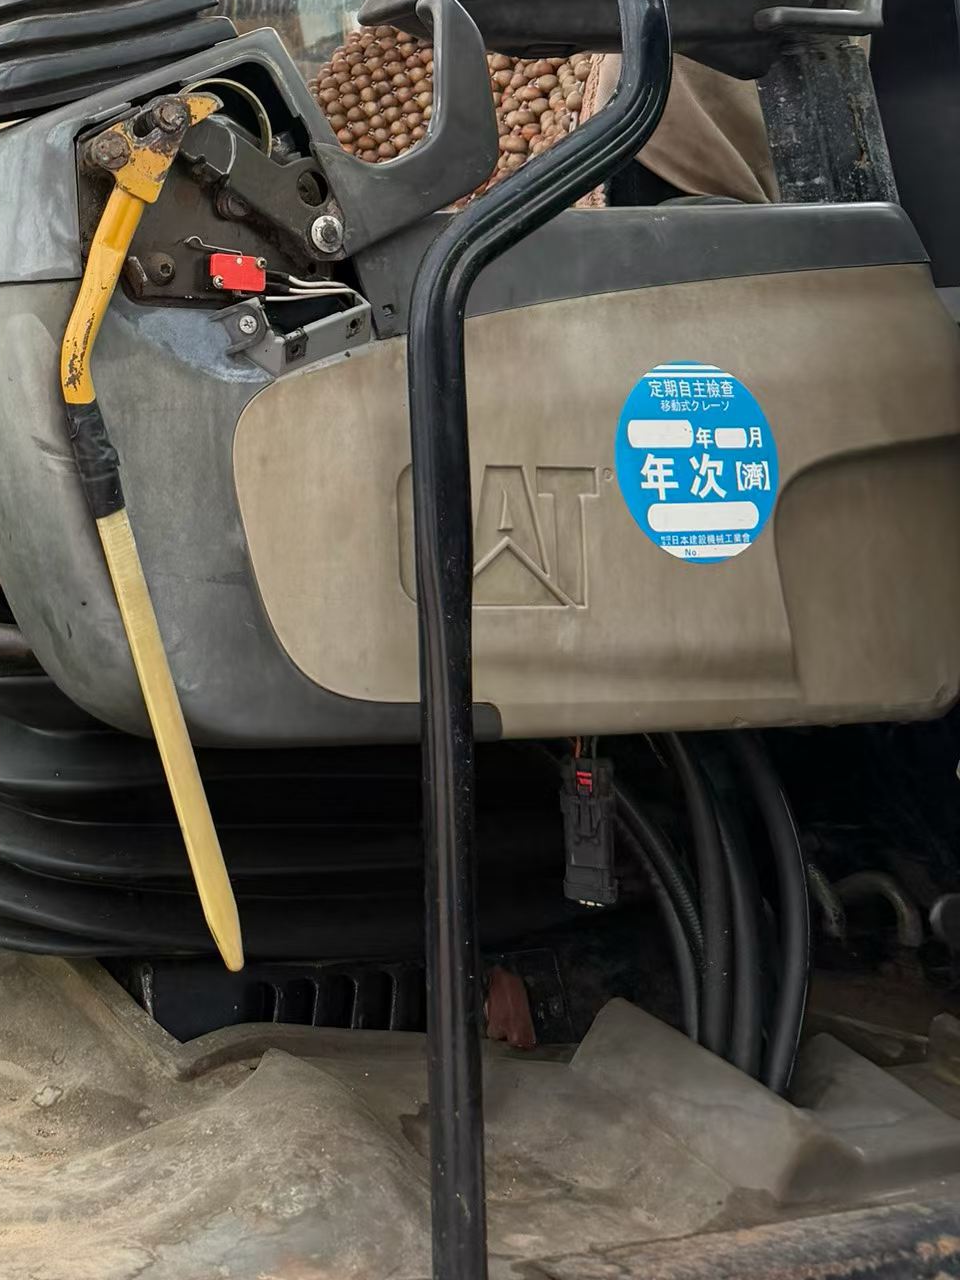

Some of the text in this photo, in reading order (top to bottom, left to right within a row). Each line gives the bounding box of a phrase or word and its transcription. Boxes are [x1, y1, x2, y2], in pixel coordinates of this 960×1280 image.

[695, 426, 763, 449] 年 月
[396, 463, 601, 610] AT
